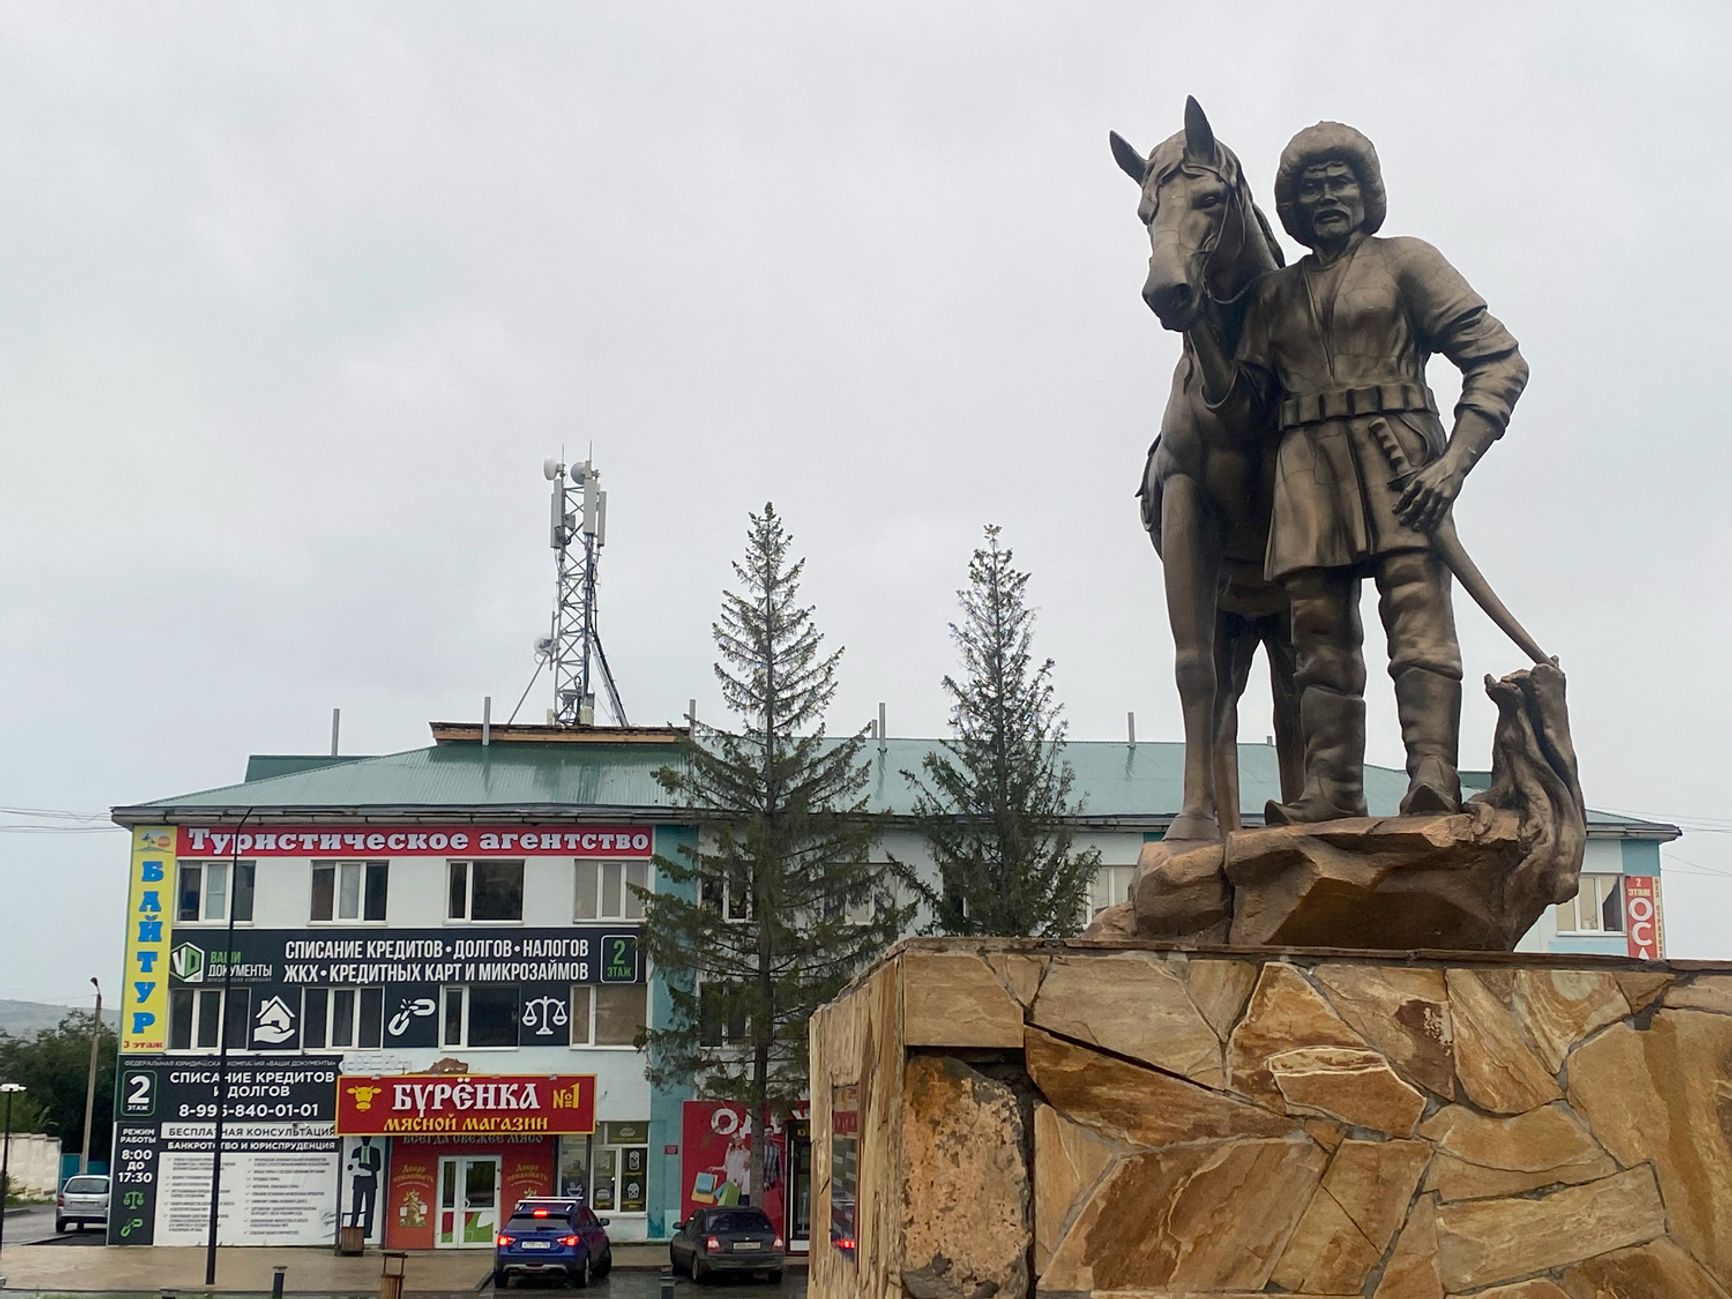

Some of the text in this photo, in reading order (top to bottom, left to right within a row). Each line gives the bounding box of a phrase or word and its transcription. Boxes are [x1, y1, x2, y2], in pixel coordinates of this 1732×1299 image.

[188, 828, 649, 855] Туристическое агентство
[1635, 878, 1643, 887] 2
[131, 860, 164, 1034] БАЙТУР
[285, 939, 589, 960] СПИСАНИЕ КРЕДИТОВ ДОЛГОВ НАЛОГОВ
[612, 939, 626, 965] 2
[283, 959, 589, 985] ЖКХ КРЕДИТНЫХ КАРТ И МИКРОЗАЙМОВ
[607, 966, 632, 978] ЭТАЖ
[123, 1040, 130, 1048] 3
[256, 1072, 335, 1085] КРЕДИТОВ
[127, 1075, 151, 1104] 2
[227, 1085, 290, 1098] ДОЛГОВ
[552, 1082, 580, 1109] №1
[391, 1077, 541, 1118] БУРЁНКА
[122, 1128, 155, 1136] РЕЖИМ
[169, 1127, 335, 1138] БЕСПЛАНАЯ КОНСУЛЬТАЦИЯ
[120, 1136, 156, 1144] РАБОТЫ
[168, 1142, 238, 1150] БАНКРОТТВО
[250, 1141, 336, 1151] ЮРИСПРУДЕНЦИЯ
[121, 1150, 152, 1161] 8:00
[127, 1161, 145, 1171] ДО
[118, 1172, 152, 1183] 17:30
